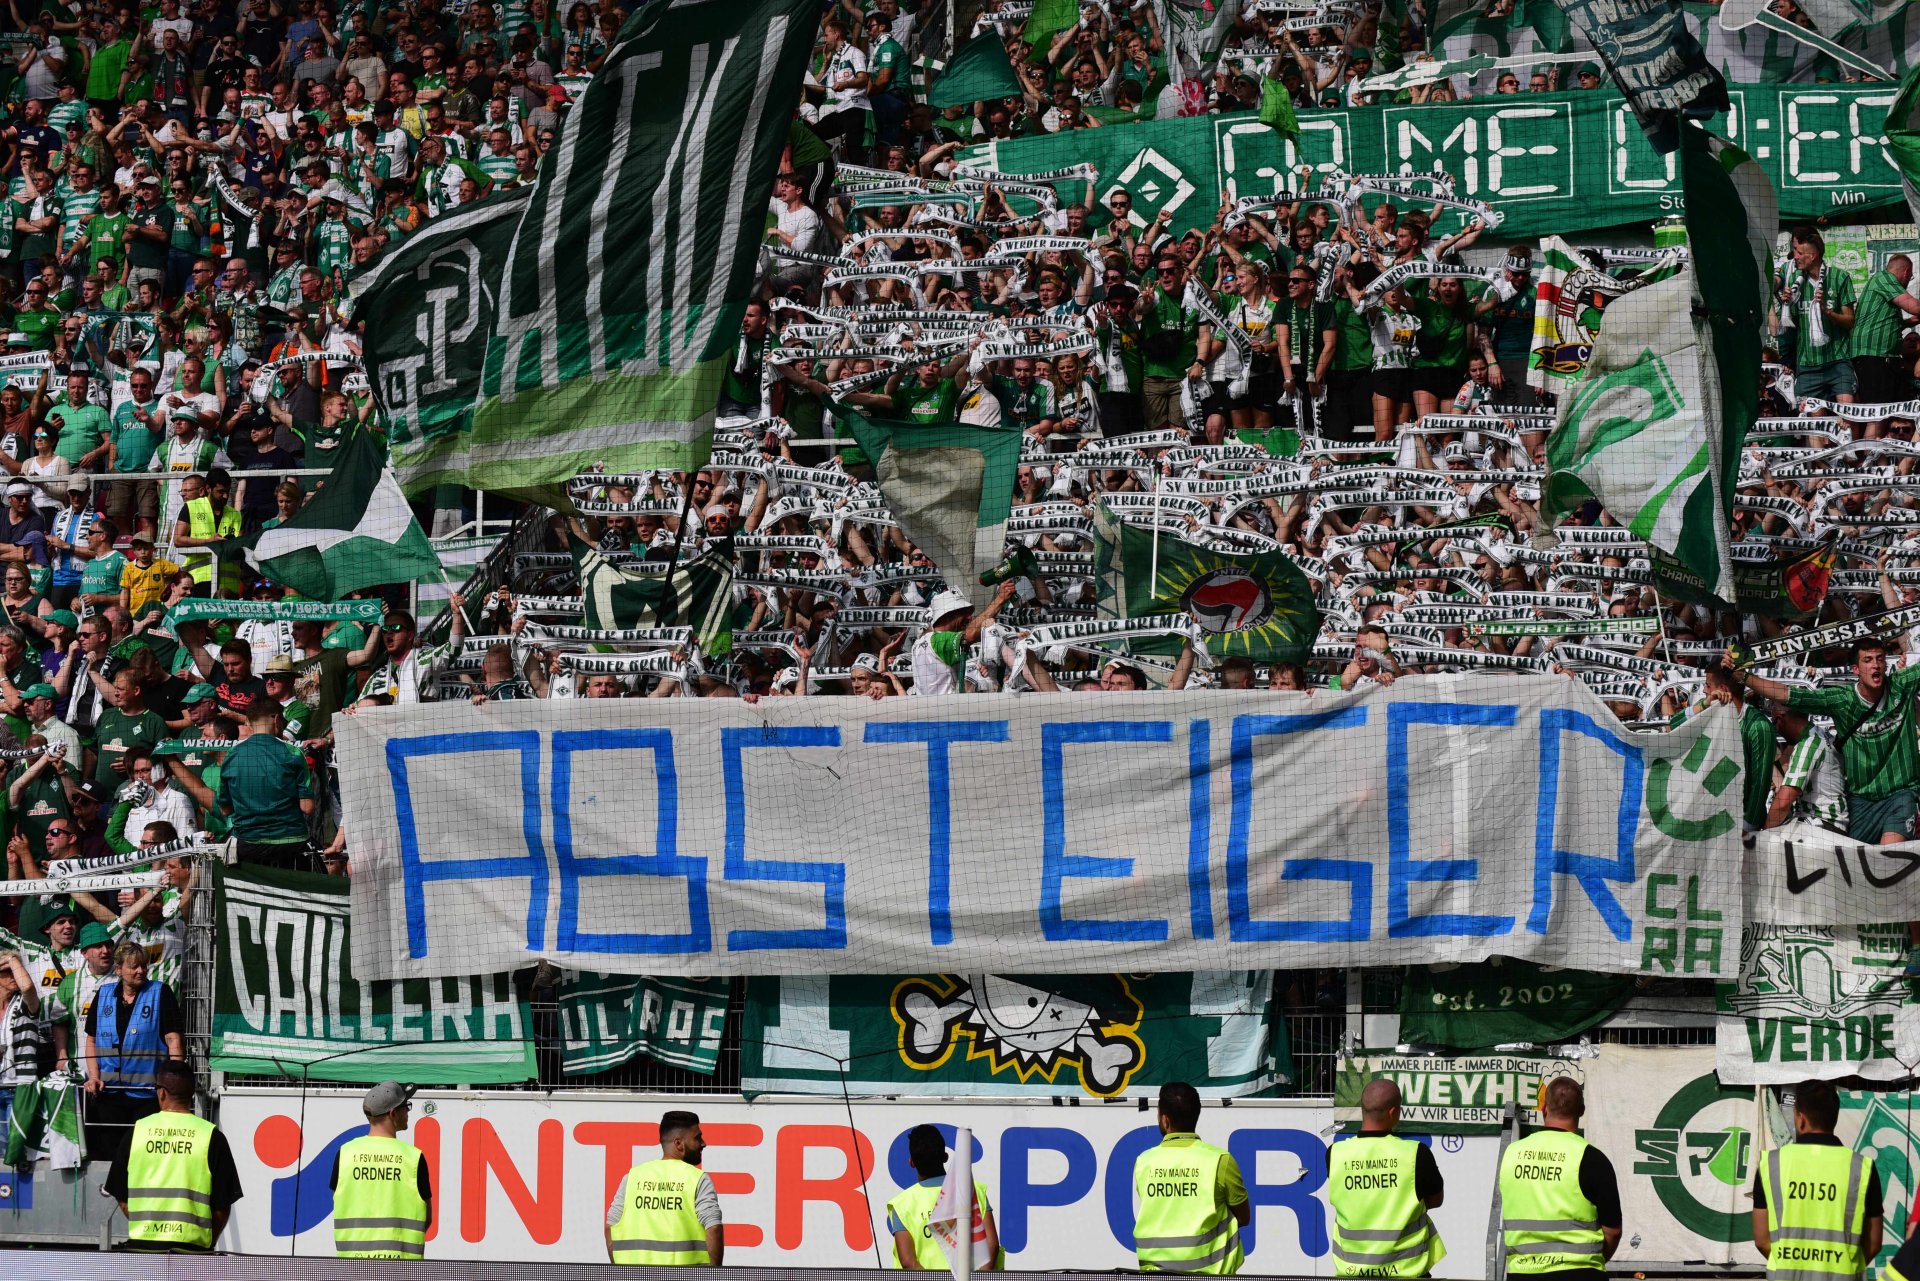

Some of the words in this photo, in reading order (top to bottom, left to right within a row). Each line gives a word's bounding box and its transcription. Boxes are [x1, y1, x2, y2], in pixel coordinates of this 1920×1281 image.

[1291, 16, 1324, 27] WERDER
[974, 168, 987, 179] SV
[1032, 165, 1074, 180] BREMEN
[1371, 179, 1385, 190] SV
[1388, 182, 1433, 198] WERDER
[1435, 193, 1480, 207] BREMEN
[1242, 196, 1256, 207] SV
[1456, 209, 1505, 228] Tae
[862, 229, 904, 242] WERDER
[1005, 238, 1047, 250] WERDER
[1373, 280, 1388, 294] SV
[1387, 263, 1430, 284] WERDER
[1432, 263, 1488, 276] BREMEN
[986, 341, 999, 354] SV
[1002, 339, 1051, 355] WERDER
[8, 354, 49, 366] BREMEN
[774, 350, 789, 360] SV
[261, 364, 274, 378] SV
[1807, 398, 1821, 409] SV
[1825, 402, 1877, 418] WERDER
[1788, 420, 1842, 435] BREMEN
[1094, 434, 1157, 448] WERDER
[1305, 439, 1317, 450] SV
[171, 463, 192, 472] DBV
[716, 452, 767, 468] BREMEN
[1166, 481, 1182, 493] SV
[1187, 480, 1241, 494] WERDER
[1246, 470, 1302, 487] BREMEN
[1226, 492, 1242, 506] SV
[1331, 492, 1391, 505] WERDER
[1395, 490, 1458, 502] BREMEN
[1818, 488, 1833, 498] SV
[573, 499, 625, 513] WERDER
[628, 498, 679, 512] BREMEN
[782, 497, 796, 510] SV
[846, 500, 859, 511] SV
[1102, 495, 1155, 507] WERDER
[1160, 496, 1209, 520] BREMEN
[1748, 497, 1805, 520] BREMEN
[766, 535, 824, 549] BREMEN
[1335, 536, 1351, 548] SV
[1572, 531, 1627, 543] WERDER
[1344, 576, 1359, 590] SV
[296, 601, 351, 615] HOPSTEN
[521, 601, 533, 611] SV
[1490, 594, 1550, 607] WERDER
[837, 609, 891, 622] WERDER
[541, 627, 617, 640] WERDER
[1024, 633, 1042, 645] SV
[1049, 621, 1120, 641] WERDER
[1124, 613, 1193, 631] BREMEN
[1490, 624, 1548, 635] ULTRA
[1553, 622, 1601, 633] TEAM
[1607, 618, 1660, 632] 2002
[1753, 620, 1872, 661] L'INTESA
[561, 656, 624, 671] WERDER
[1393, 650, 1410, 663] SV
[1484, 653, 1550, 674] BREMEN
[1563, 647, 1624, 667] WERDER
[183, 738, 236, 749] WERDE
[386, 702, 1644, 960] ABSTEIGER
[57, 861, 73, 876] SV
[78, 852, 132, 871] WERDER
[136, 834, 195, 862] BREMEN
[1500, 983, 1575, 1007] 2002
[141, 1005, 151, 1019] 9
[1744, 1013, 1897, 1063] VERDE
[1381, 1058, 1420, 1071] IMMER
[1423, 1059, 1457, 1072] PLEITE
[1465, 1058, 1503, 1072] IMMER
[1506, 1060, 1541, 1073] DICHT
[1383, 1073, 1541, 1108] WEYHE
[1422, 1107, 1448, 1121] WIR
[1453, 1108, 1500, 1122] LIEBEN
[154, 1128, 167, 1138] FSV
[168, 1128, 187, 1138] MAINZ
[188, 1129, 196, 1138] 05
[145, 1140, 193, 1156] ORDNER
[359, 1153, 373, 1163] FSV
[373, 1153, 393, 1164] MAINZ
[394, 1154, 403, 1164] 05
[1523, 1150, 1536, 1160] FSV
[1537, 1150, 1557, 1162] MAINZ
[1558, 1152, 1566, 1162] 05
[1351, 1160, 1364, 1171] FSV
[1365, 1159, 1388, 1170] MAINZ
[1389, 1158, 1398, 1168] 05
[352, 1166, 402, 1182] ORDNER
[1155, 1168, 1168, 1178] FSV
[1169, 1167, 1190, 1178] MAINZ
[1191, 1167, 1199, 1178] 05
[1514, 1164, 1563, 1182] ORDNER
[413, 1117, 1433, 1258] INTERPR
[643, 1181, 658, 1191] FSV
[677, 1182, 685, 1192] 05
[1344, 1173, 1398, 1190] ORDNER
[1147, 1182, 1198, 1197] ORDNER
[1788, 1180, 1837, 1202] 20150
[635, 1194, 683, 1211] ORDNER
[153, 1223, 183, 1234] MEWA
[1531, 1255, 1565, 1265] MEWA
[1777, 1246, 1844, 1264] SECURITY
[1358, 1264, 1399, 1278] MEWA
